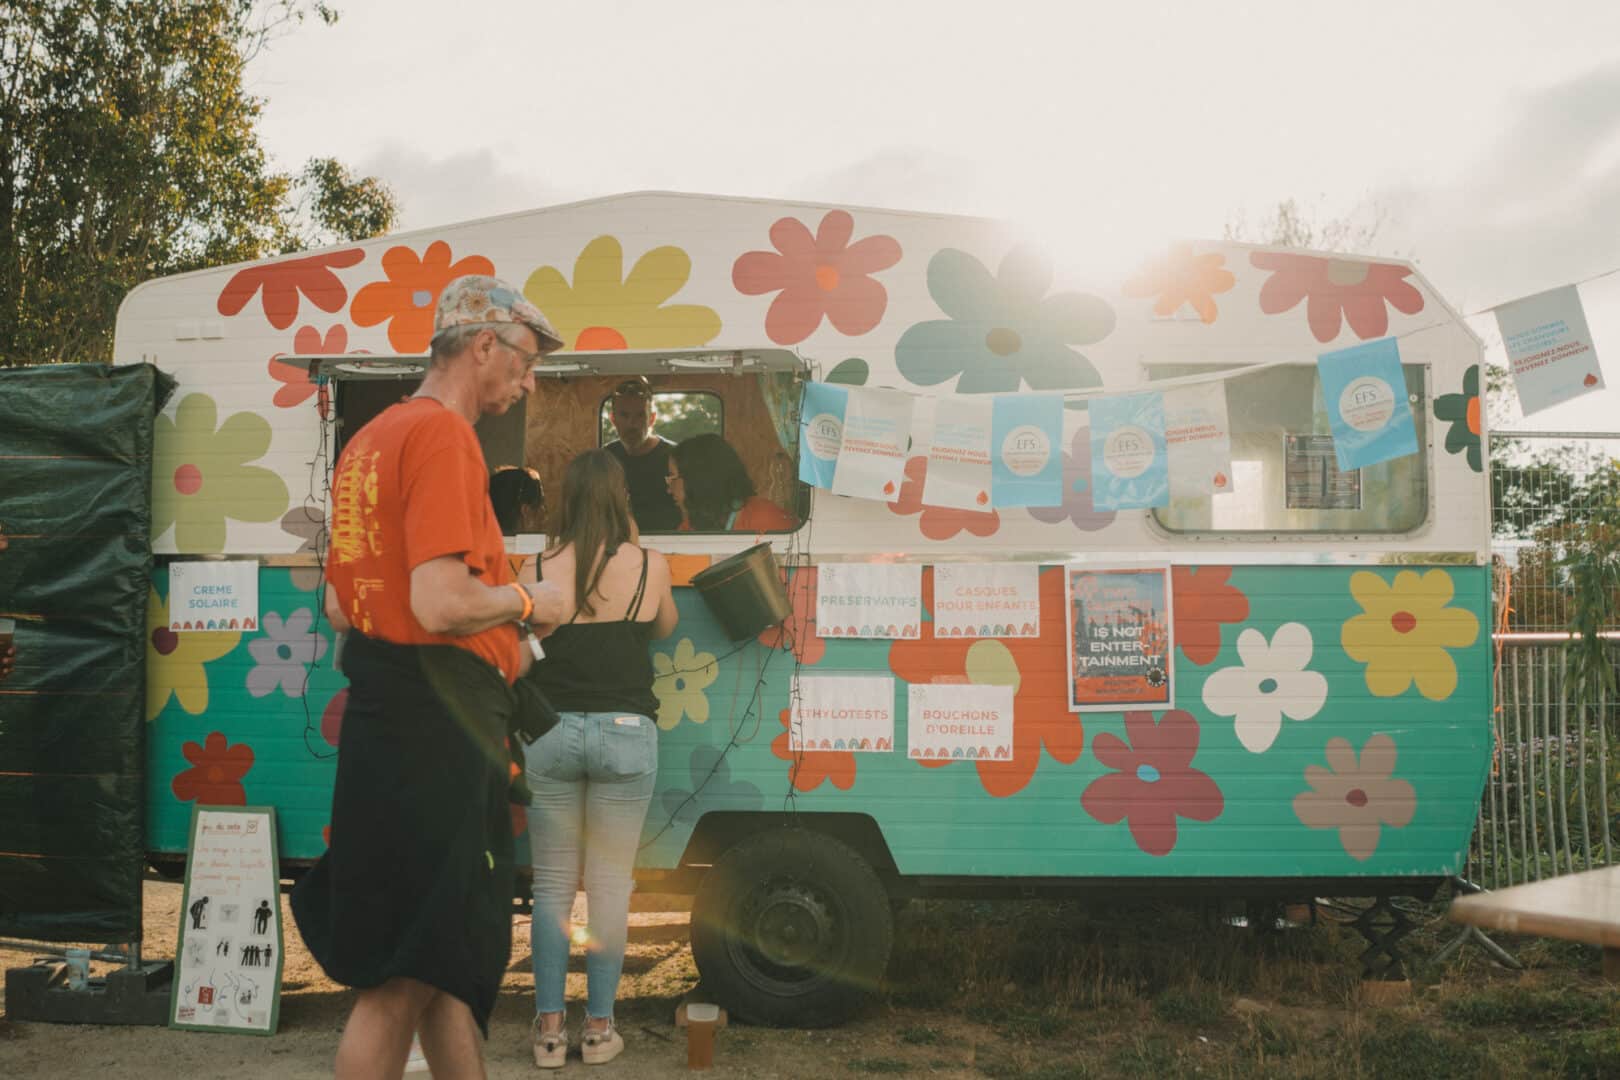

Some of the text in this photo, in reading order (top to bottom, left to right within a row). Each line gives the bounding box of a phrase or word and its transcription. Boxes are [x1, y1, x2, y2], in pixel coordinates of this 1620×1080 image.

[1354, 390, 1377, 405] EFS
[193, 585, 233, 595] CREME
[954, 586, 1017, 596] CASQUES
[189, 599, 239, 608] SOLAIRE
[821, 596, 917, 607] PRESERVATIFS
[936, 601, 1037, 610] POUR ENFANTS
[1094, 626, 1144, 637] IS NOT
[1090, 640, 1151, 652] ENTER-
[1080, 655, 1161, 667] TAINMENT
[923, 710, 999, 720] BOUCHONS
[926, 724, 994, 735] D'OREILLE
